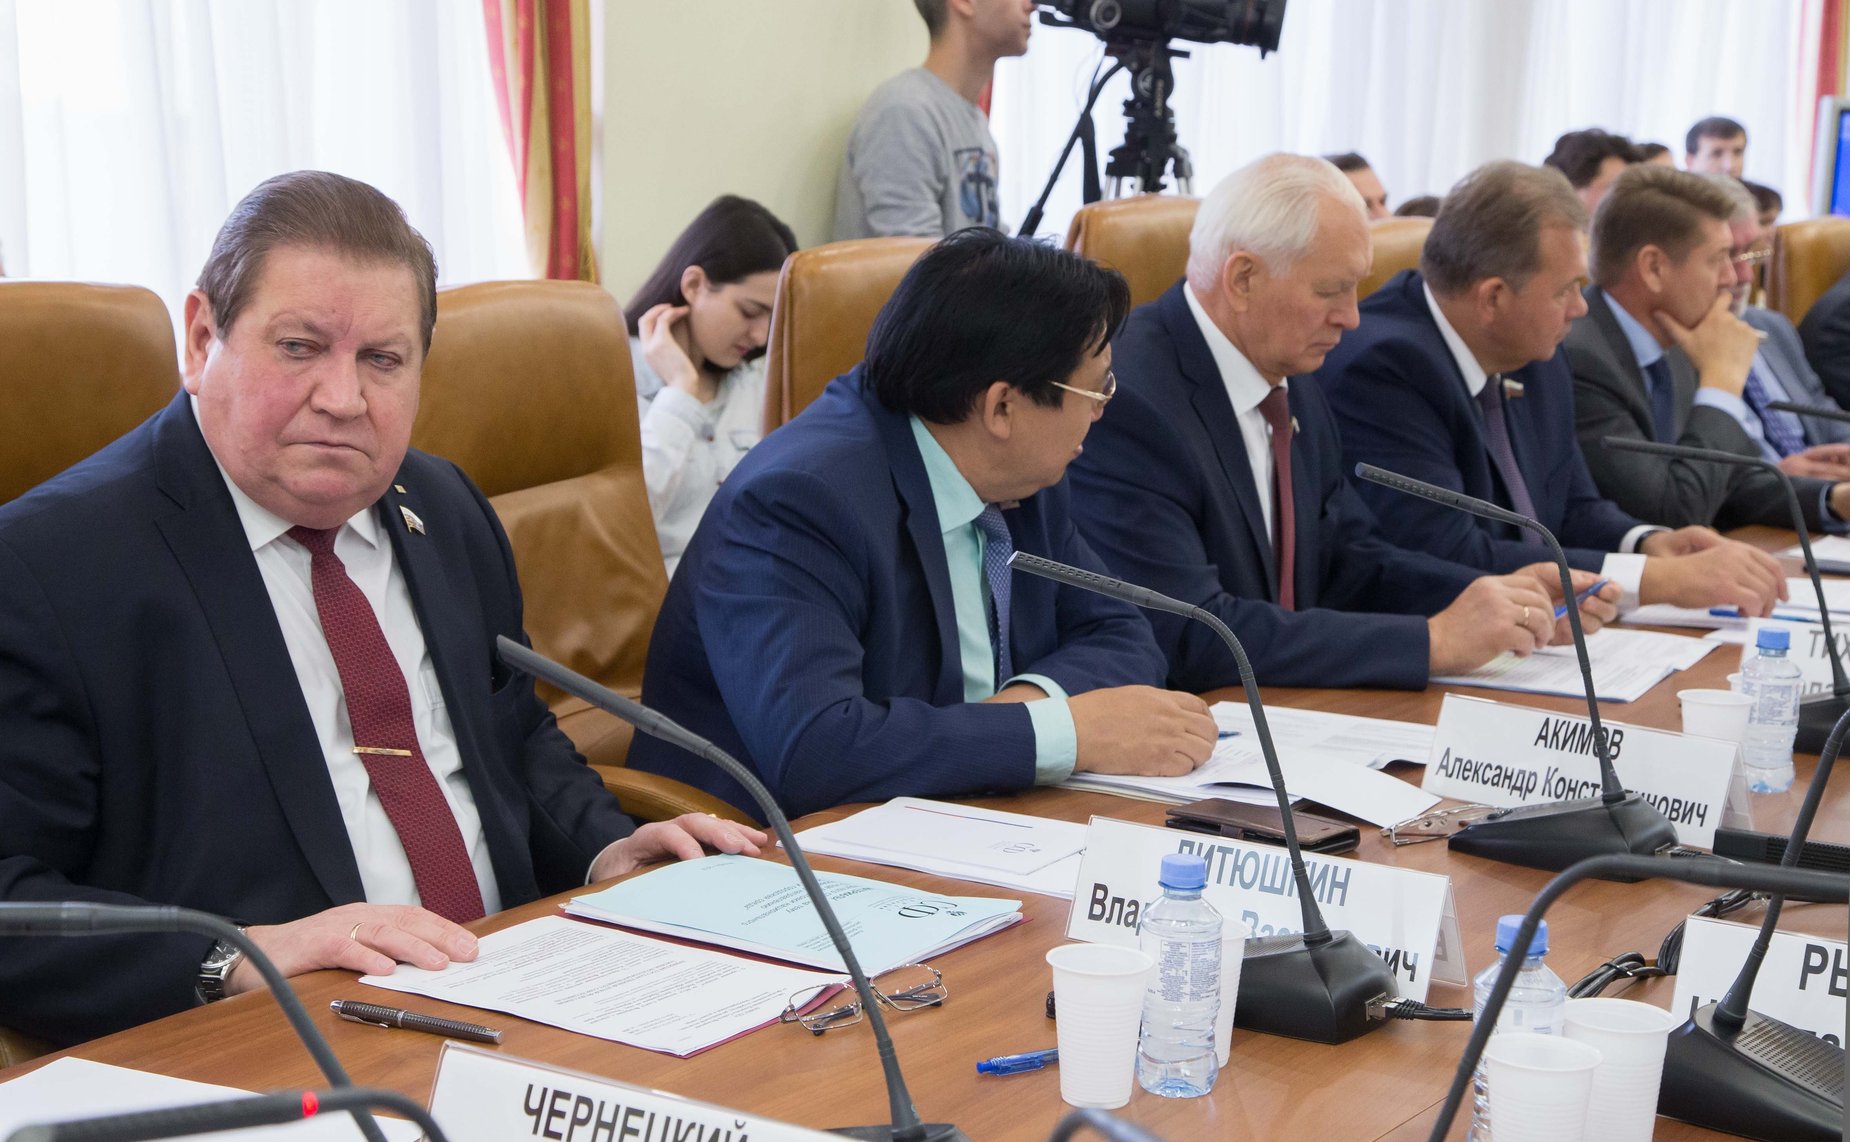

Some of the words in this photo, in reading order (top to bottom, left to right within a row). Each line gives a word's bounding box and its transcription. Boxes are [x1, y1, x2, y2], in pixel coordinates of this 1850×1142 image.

[1534, 717, 1624, 760] АКИМОВ
[1435, 746, 1537, 801] Александр
[1542, 766, 1708, 827] Констнович
